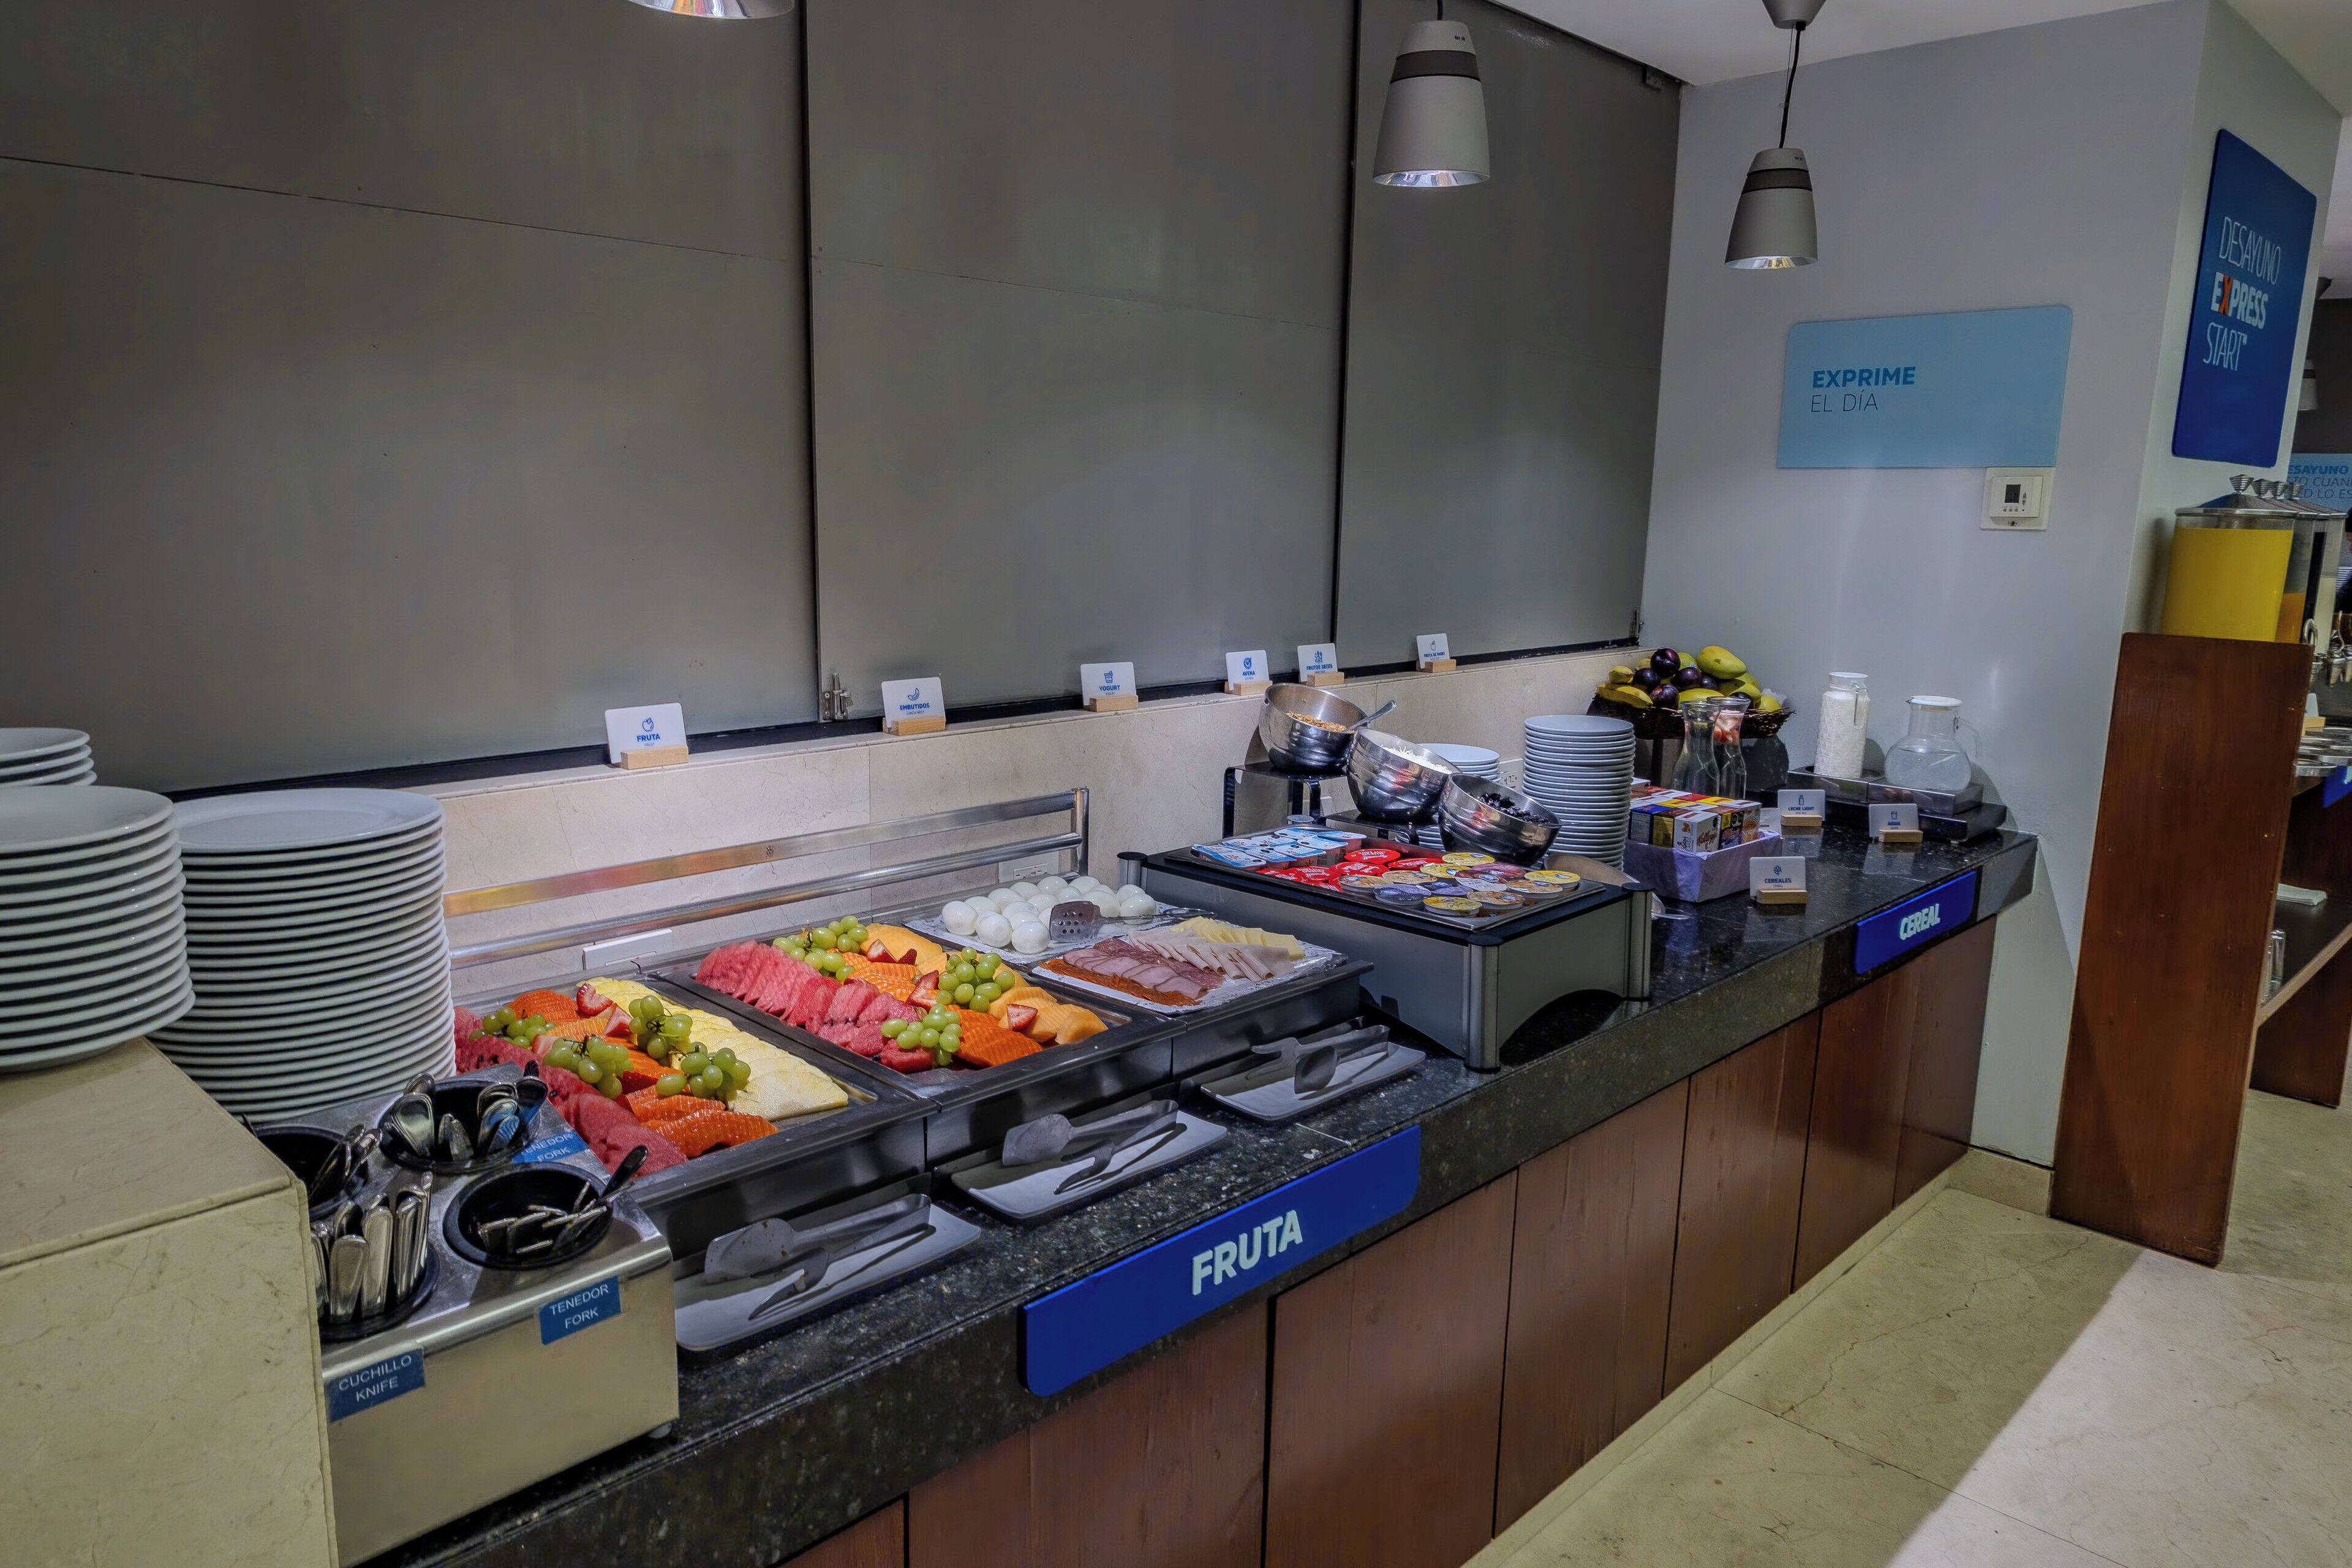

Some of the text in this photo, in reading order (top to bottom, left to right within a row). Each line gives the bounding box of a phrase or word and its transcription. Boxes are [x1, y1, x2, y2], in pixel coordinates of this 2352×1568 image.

[2218, 216, 2282, 285] DESAYUNO
[2211, 272, 2269, 330] EXPRESS
[1812, 366, 1917, 388] EXPRIME
[1811, 389, 1879, 412] EL DÍA
[899, 703, 930, 711] EMBUTIDOS
[636, 733, 662, 742] FRUTA
[1899, 903, 1941, 940] CEREAL
[537, 1147, 571, 1163] FORK
[1192, 1210, 1303, 1296] FRUTA
[549, 1283, 609, 1316] TENEDOR
[564, 1306, 599, 1329] FORK
[338, 1354, 412, 1392] CUCHILLO
[355, 1376, 399, 1403] KNIFE
